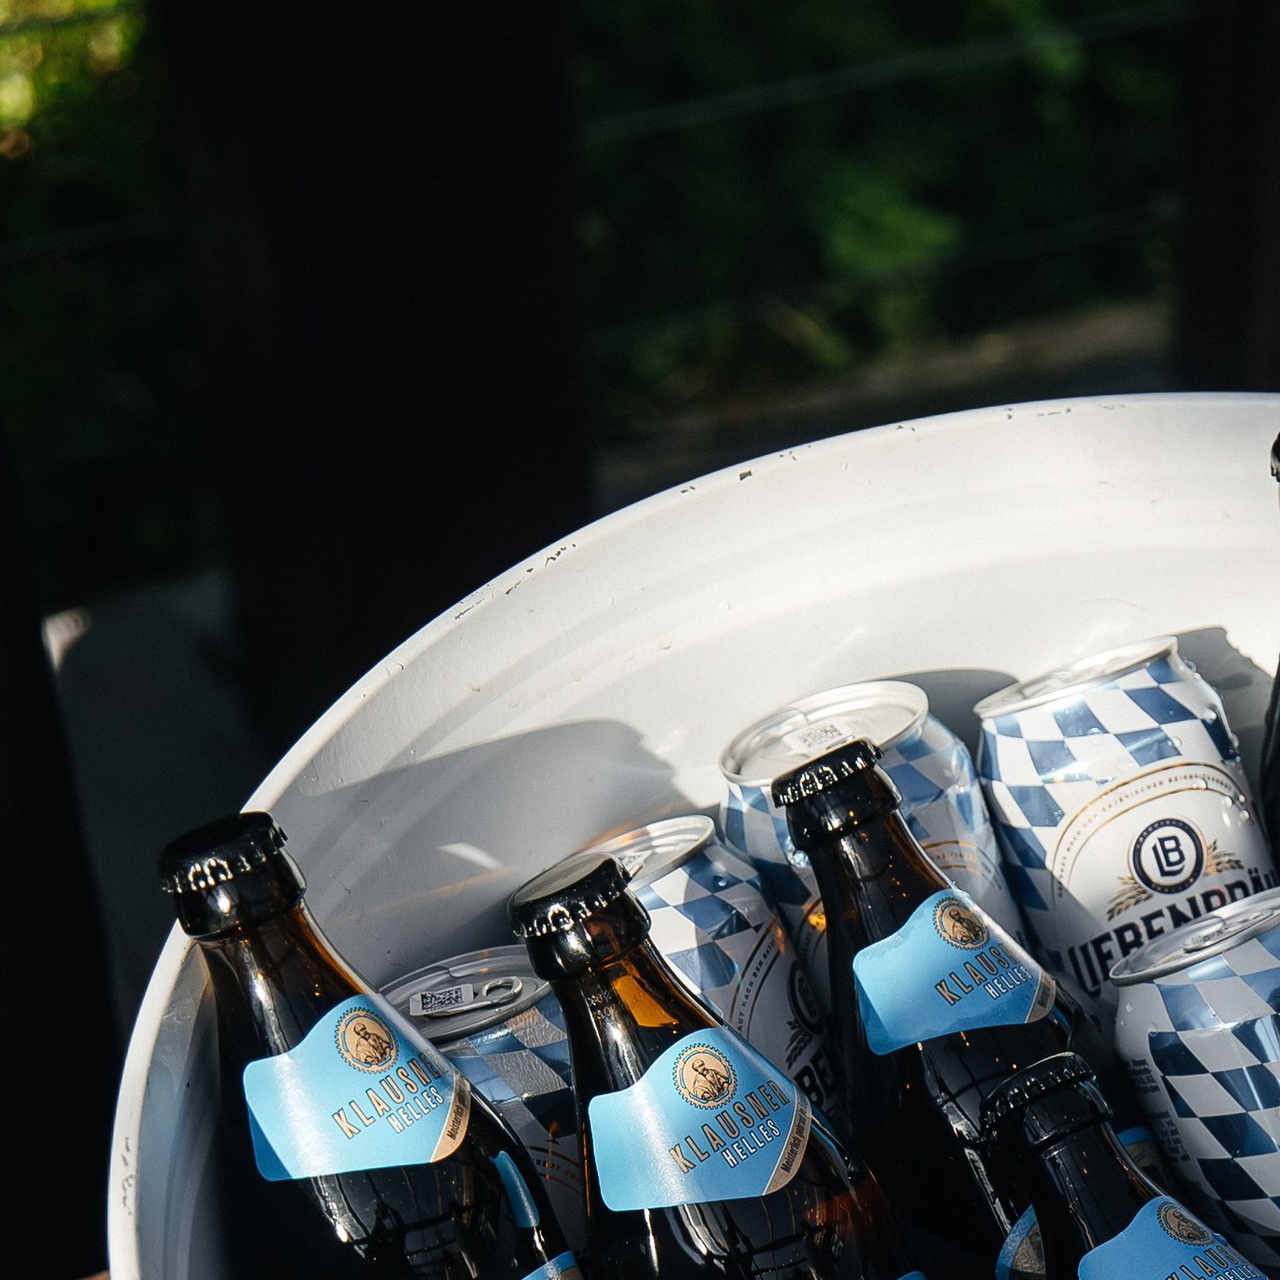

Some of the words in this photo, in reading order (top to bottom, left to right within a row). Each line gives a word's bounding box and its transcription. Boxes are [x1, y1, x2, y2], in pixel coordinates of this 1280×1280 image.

[983, 964, 1033, 1000] HELLES
[386, 1085, 444, 1134] HELLES
[669, 1080, 790, 1175] KLAUSNER
[722, 1118, 781, 1169] HELLES
